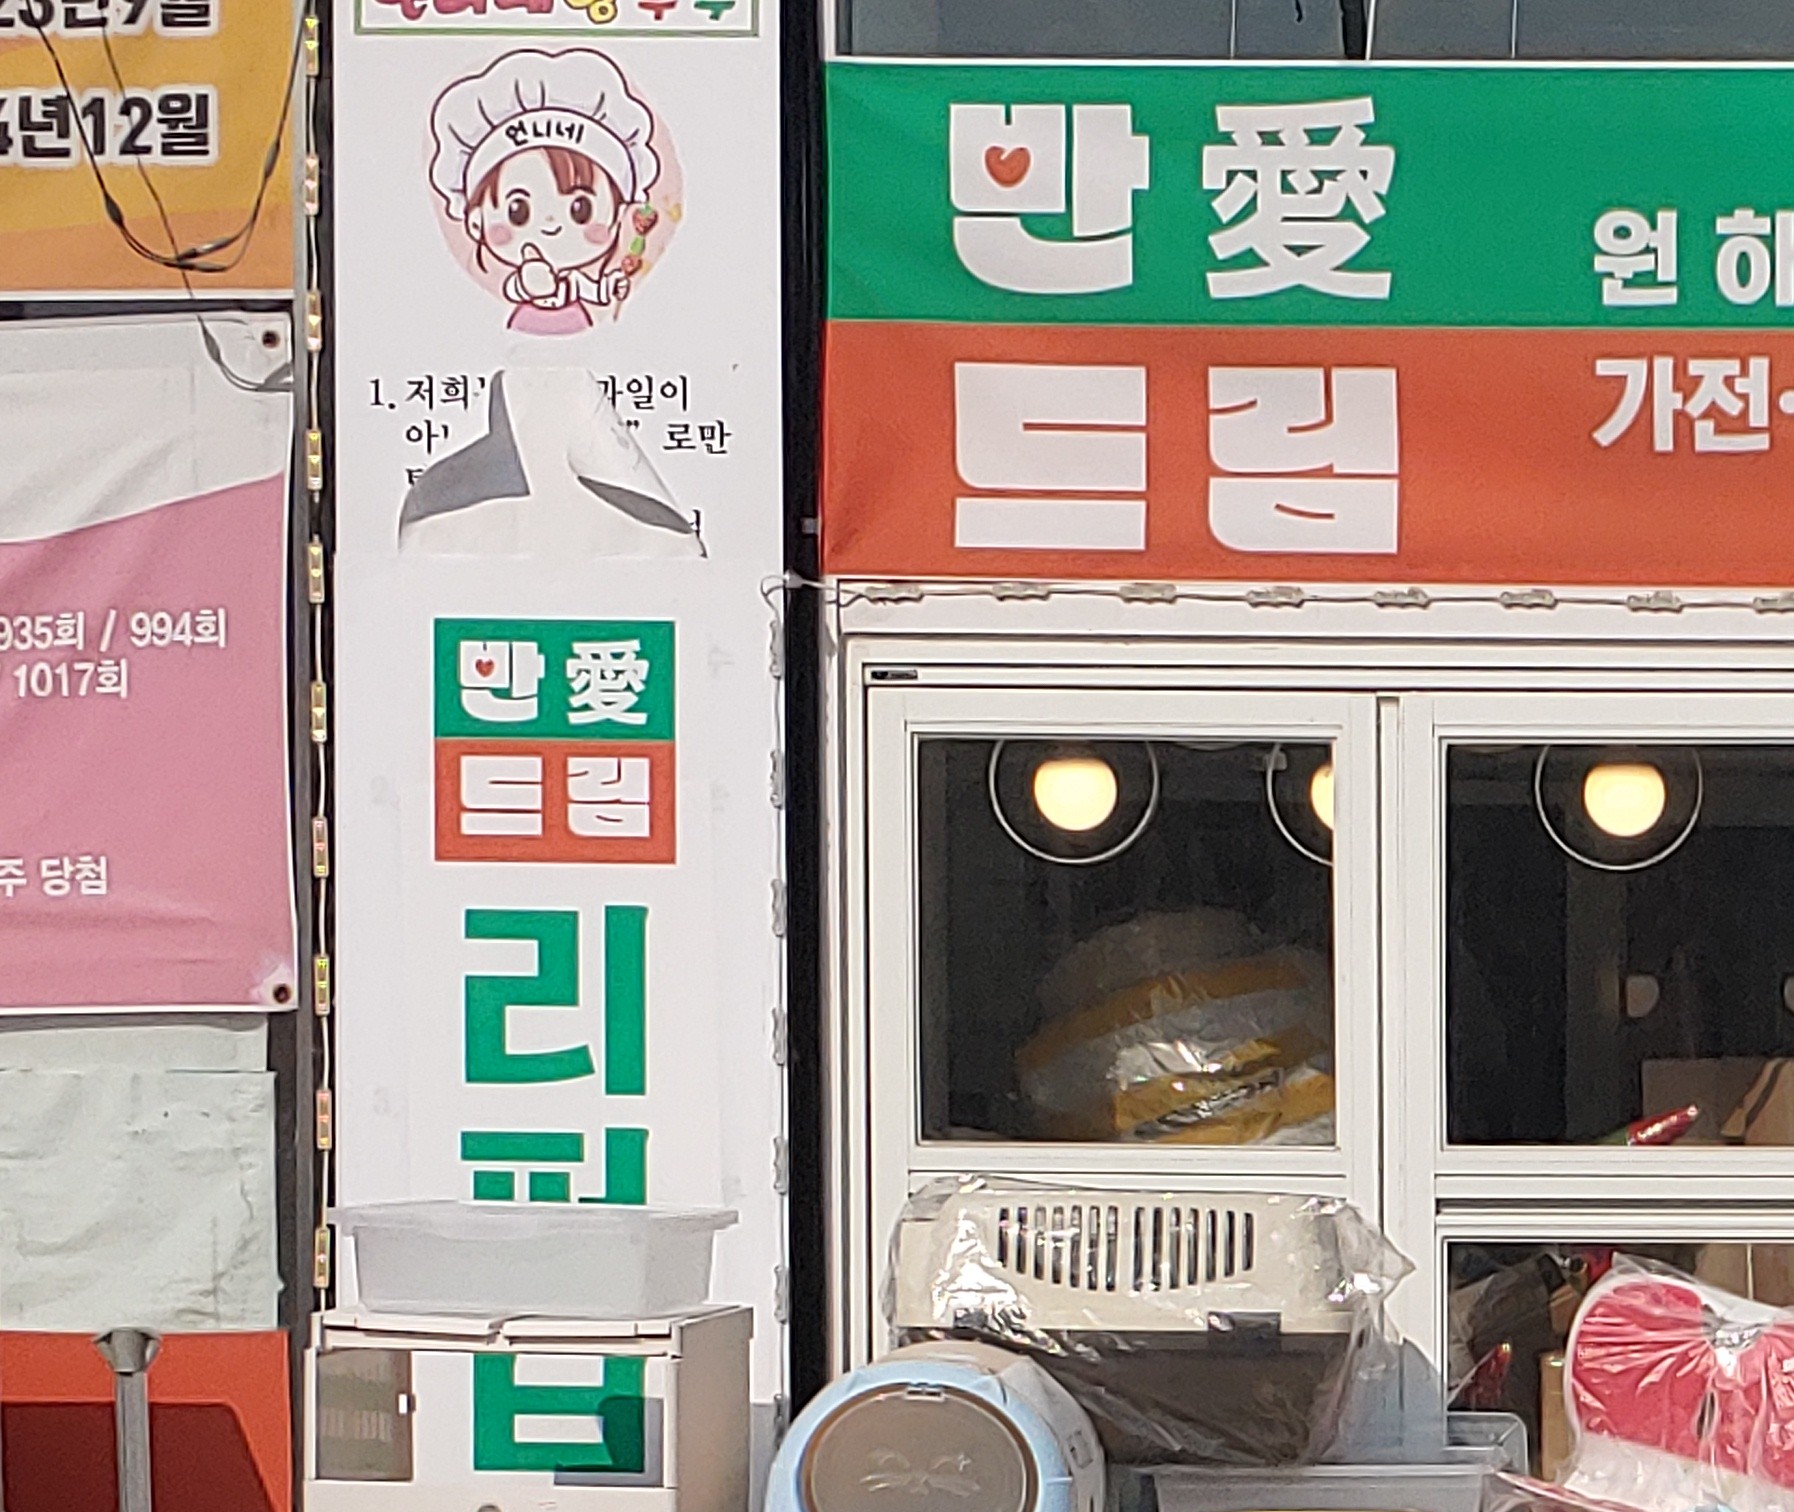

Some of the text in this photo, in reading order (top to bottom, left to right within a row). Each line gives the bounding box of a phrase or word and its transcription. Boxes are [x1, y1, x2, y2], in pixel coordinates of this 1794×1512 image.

[505, 120, 585, 146] 언니네
[662, 420, 733, 455] 로만
[954, 361, 1399, 554] 드림
[130, 608, 227, 649] 994회
[13, 657, 128, 699] 1017회
[460, 755, 651, 837] 드림
[40, 854, 108, 897] 당첨
